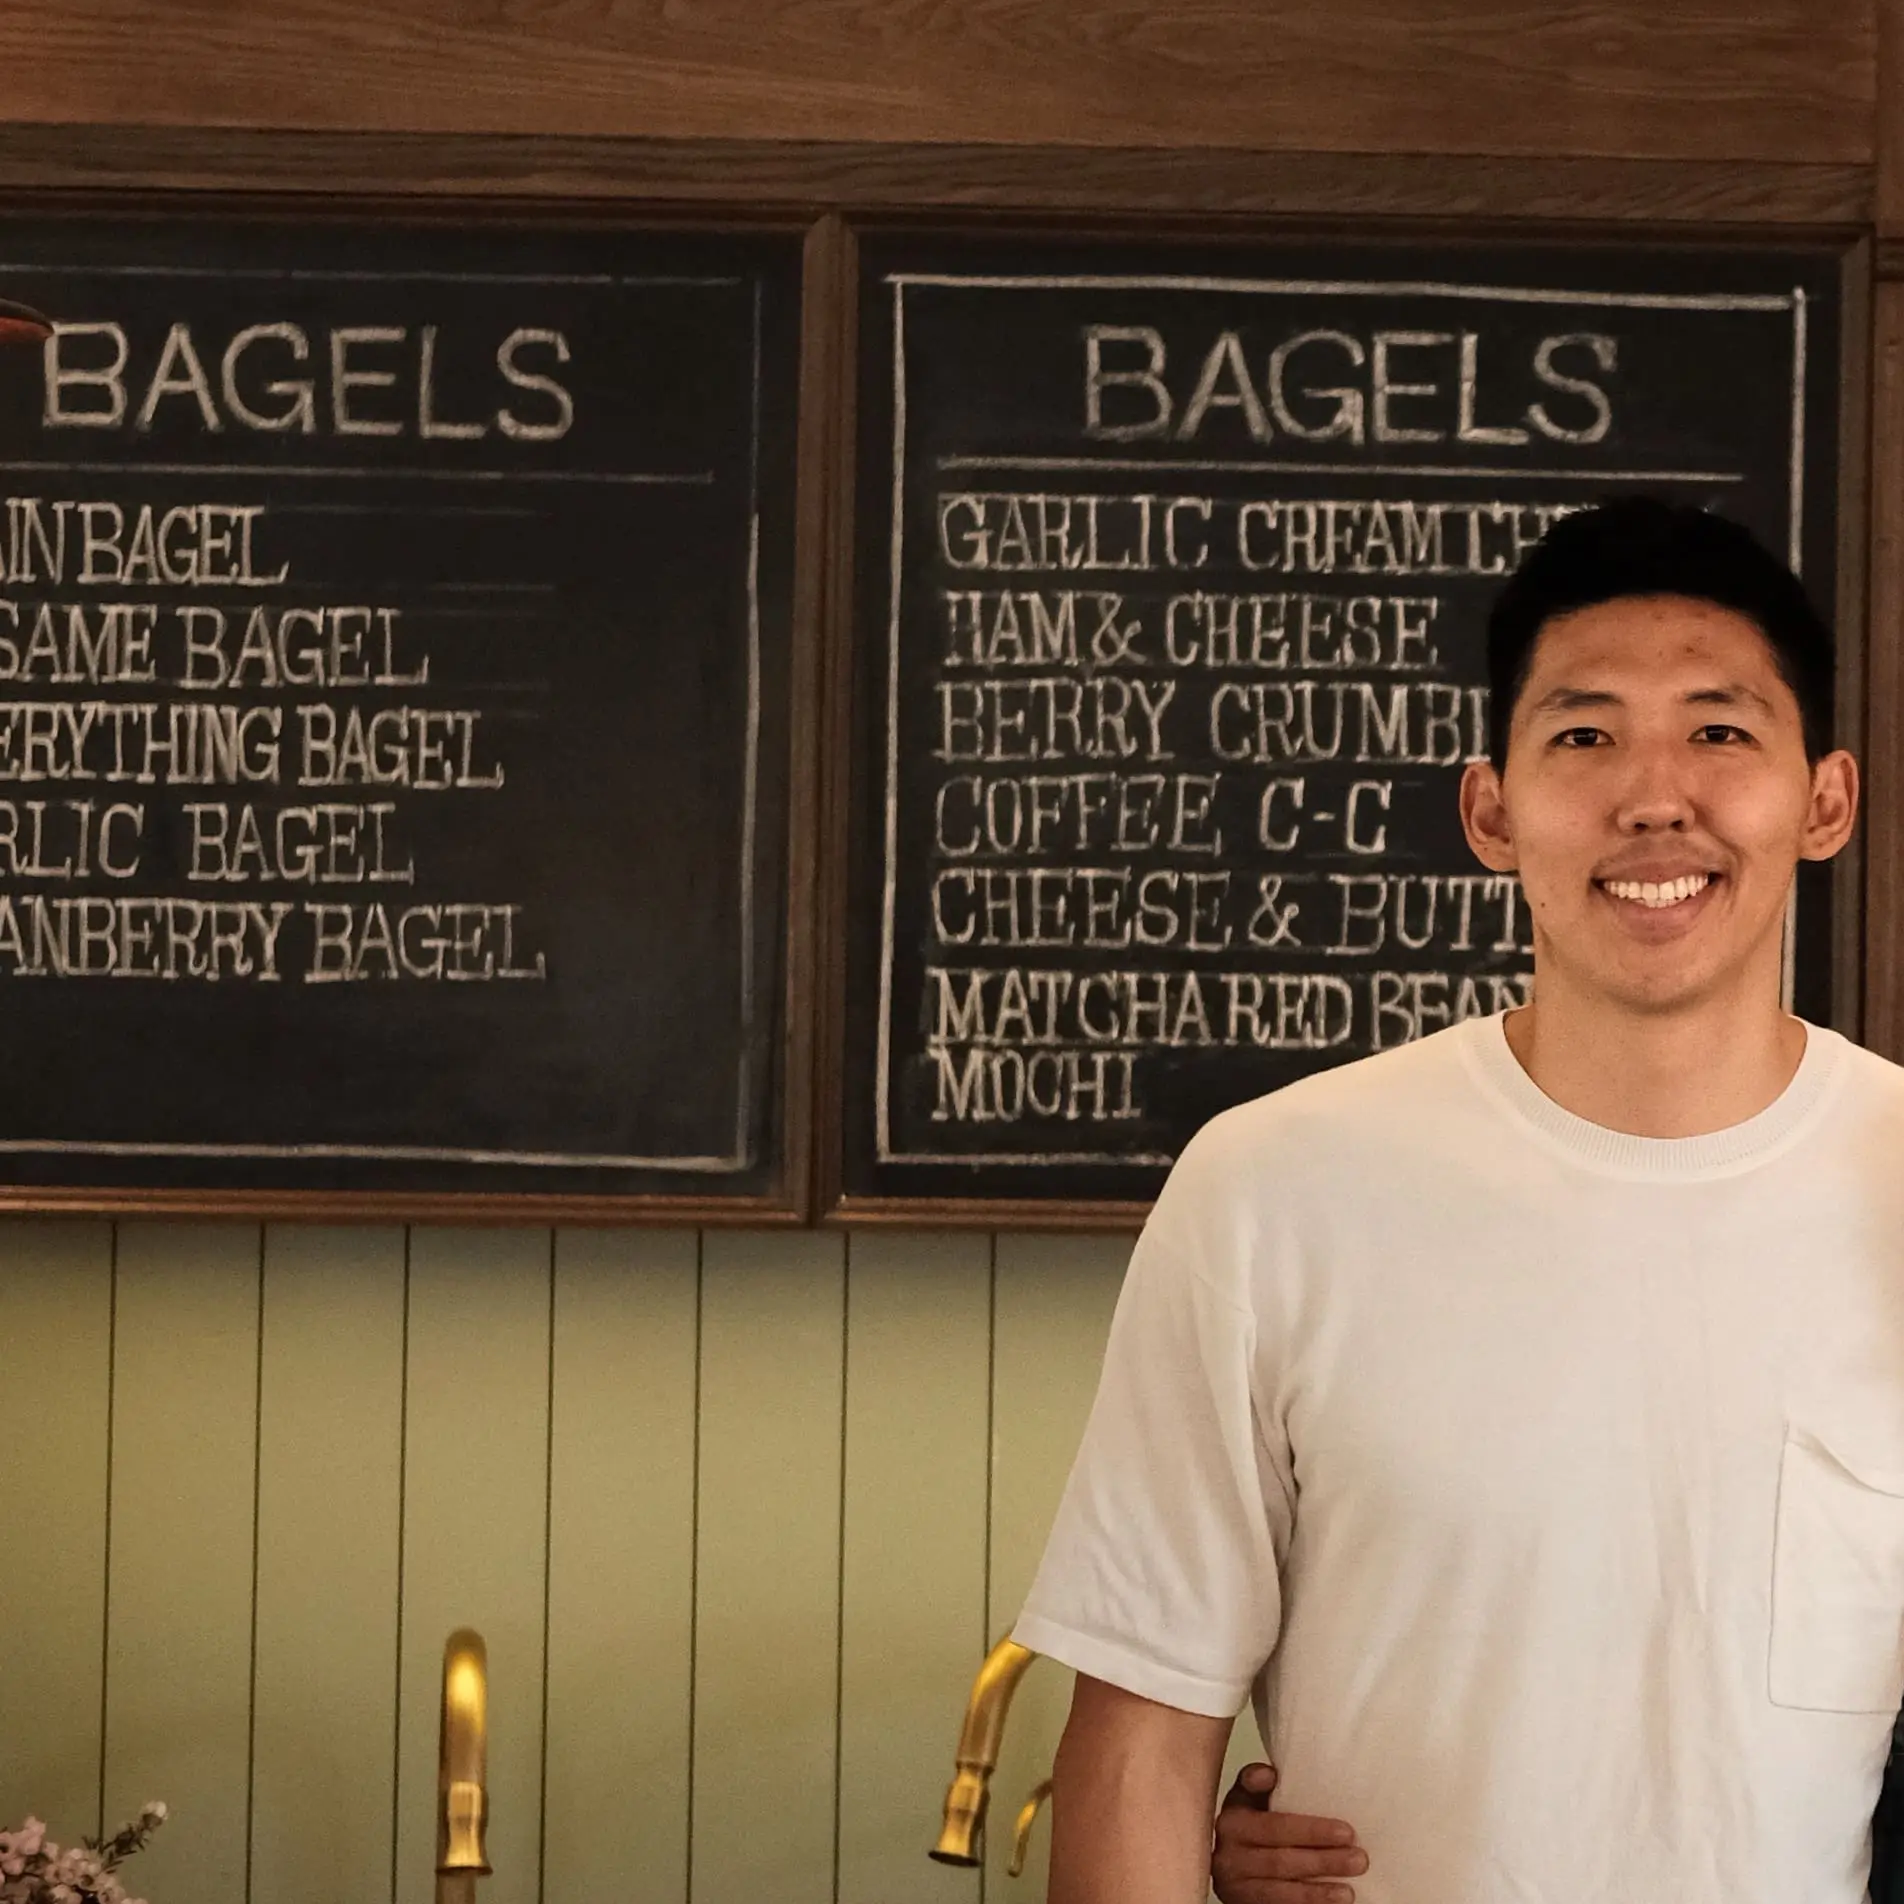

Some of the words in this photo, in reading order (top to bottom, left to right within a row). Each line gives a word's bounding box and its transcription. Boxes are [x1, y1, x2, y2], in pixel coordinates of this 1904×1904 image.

[43, 321, 574, 440] BAGELS
[1083, 324, 1618, 444] BAGELS
[0, 497, 76, 585] IN
[77, 502, 290, 586] BAGEL
[940, 493, 1213, 571] GARLIC
[1237, 499, 1452, 575] CREAM
[175, 605, 430, 689] BAGEL
[944, 590, 1085, 668] HAM
[1091, 592, 1148, 666] &
[1165, 592, 1440, 670] CHEESE
[296, 703, 504, 789] BAGEL
[932, 676, 1176, 764] BERRY
[182, 801, 415, 885] BAGEL
[936, 771, 1223, 857] COFFEE
[1259, 776, 1393, 855] C-C
[304, 901, 546, 984] BAGEL
[931, 865, 1234, 953] CHEESE
[1248, 873, 1301, 947] &
[1324, 873, 1535, 956] BUTT
[926, 966, 1212, 1047] MATCHA
[1219, 971, 1353, 1049] RED
[926, 1046, 1141, 1121] MOCHI
